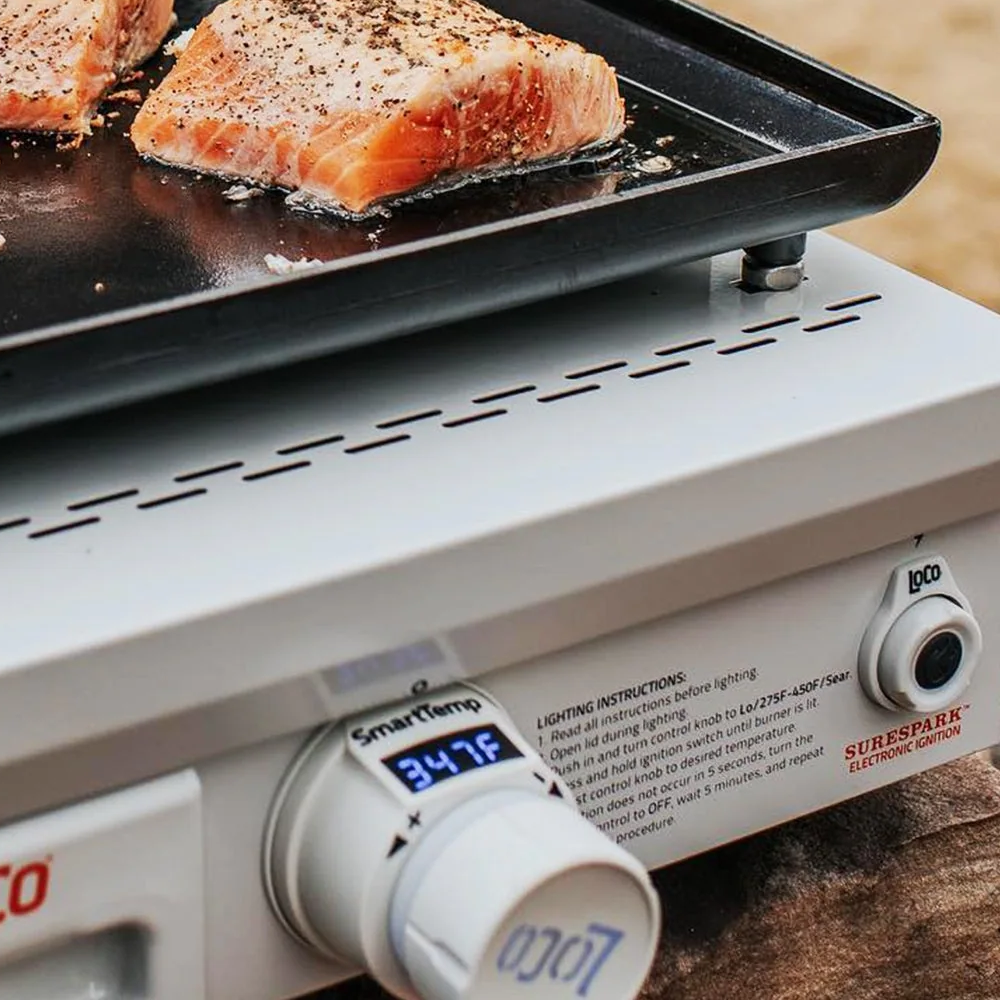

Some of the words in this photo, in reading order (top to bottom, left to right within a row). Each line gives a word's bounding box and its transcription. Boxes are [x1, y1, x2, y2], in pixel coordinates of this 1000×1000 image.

[351, 698, 482, 747] SmartTemp
[537, 700, 593, 730] LIGHTING
[596, 671, 686, 710] INSTRUCTIONS:
[550, 723, 581, 742] Read
[583, 717, 597, 732] all
[601, 695, 671, 726] instructions
[674, 682, 711, 702] before
[396, 731, 500, 791] 347F
[550, 743, 581, 761] Open
[584, 734, 598, 749] lid
[601, 723, 639, 744] during
[583, 756, 594, 767] in
[597, 745, 619, 764] and
[623, 738, 647, 754] turn
[650, 721, 690, 745] control
[694, 712, 722, 730] knob
[725, 708, 736, 720] to
[585, 766, 608, 784] and
[611, 757, 636, 775] hold
[639, 744, 682, 768] ignition
[686, 729, 723, 750] switch
[726, 718, 751, 737] until
[754, 707, 791, 727] burner
[794, 702, 803, 713] is
[849, 741, 914, 773] ELECTRONIC
[914, 725, 961, 752] IGNITION
[589, 776, 630, 800] control
[634, 766, 662, 785] knob
[665, 763, 677, 774] to
[679, 745, 722, 769] desired
[596, 811, 630, 831] ntrol
[633, 808, 645, 821] to
[676, 788, 700, 805] wait
[704, 784, 711, 796] 5
[765, 757, 785, 774] and
[788, 745, 823, 765] repeat
[606, 795, 634, 812] does
[638, 786, 657, 801] not
[660, 775, 690, 793] occur
[694, 771, 704, 781] in
[707, 765, 715, 777] 5
[768, 741, 791, 756] turn
[795, 734, 813, 747] the
